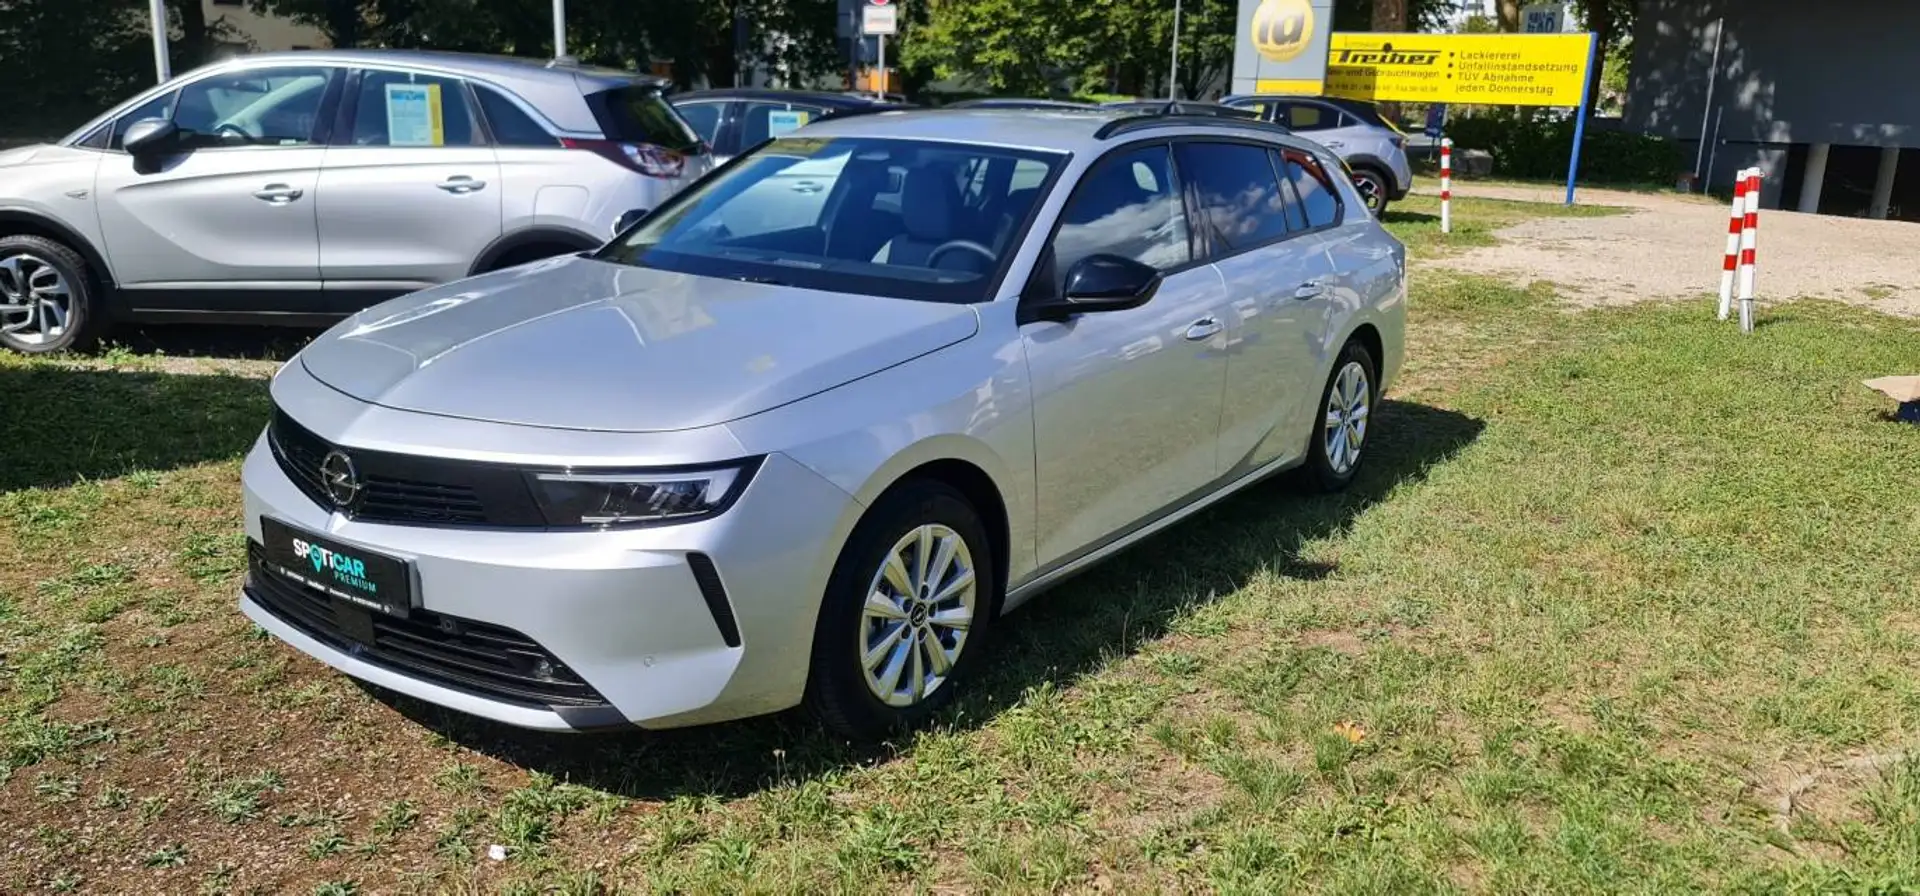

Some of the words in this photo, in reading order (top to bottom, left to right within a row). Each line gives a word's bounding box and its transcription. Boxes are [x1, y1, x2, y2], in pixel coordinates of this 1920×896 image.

[1460, 50, 1521, 61] Lackiererei
[1482, 73, 1535, 83] Abnahme
[1488, 84, 1555, 97] Donnerstag
[333, 570, 377, 593] PREMIUM
